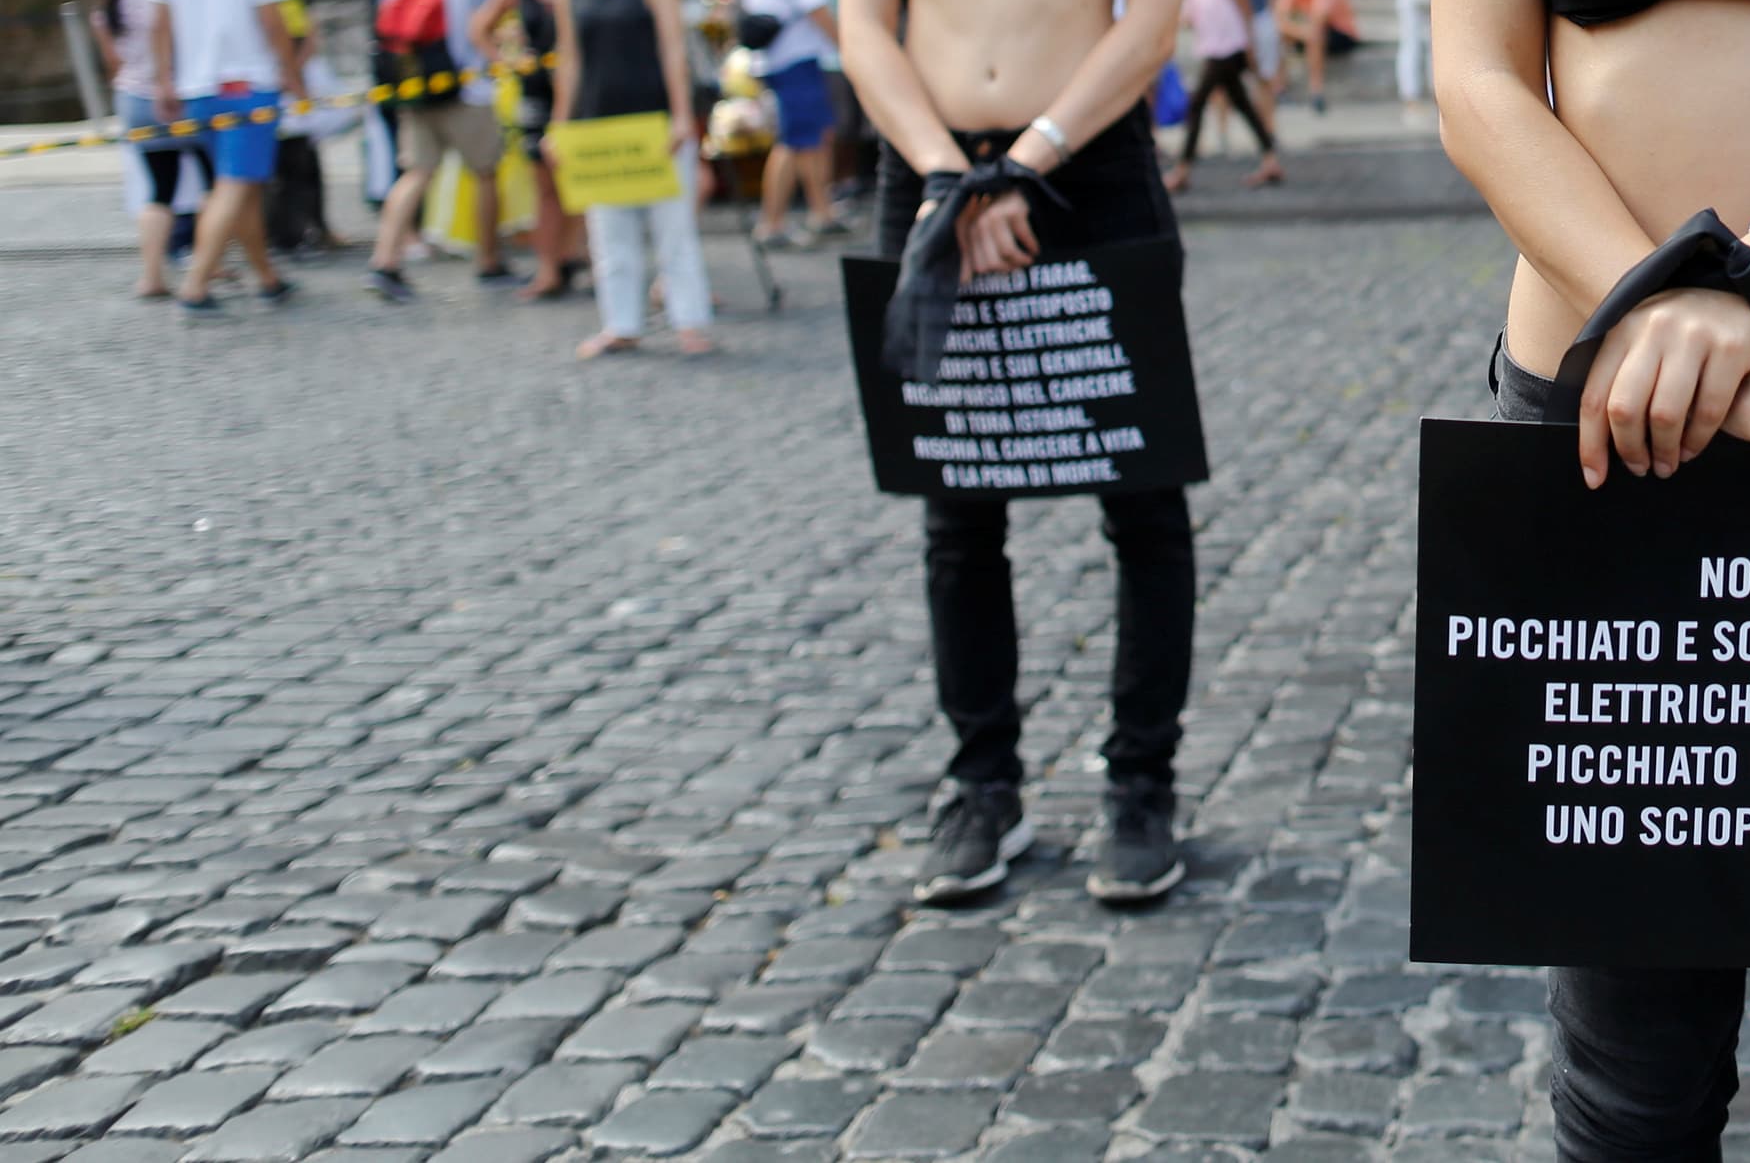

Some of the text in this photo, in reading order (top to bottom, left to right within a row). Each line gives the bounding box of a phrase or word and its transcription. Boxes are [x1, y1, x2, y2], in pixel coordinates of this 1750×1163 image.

[1029, 259, 1098, 290] FARAG.
[979, 299, 993, 324] E
[995, 287, 1114, 323] SOTTOPOSTO
[943, 316, 1114, 353] RICHE ELETTRICHE
[936, 343, 1131, 380] ORPO E SUI GENITALI.
[1011, 381, 1048, 406] NEL
[1049, 370, 1137, 403] CARCERE
[945, 410, 967, 435] DI
[967, 410, 1013, 435] TORA
[913, 425, 1145, 462] RISCHIA IL CARCERE A VITA
[942, 457, 1122, 488] O LA PENA DI MORTE.
[1448, 615, 1661, 662] PICCHIATO
[1676, 620, 1699, 662] E
[1527, 743, 1737, 786] PICCHIATO
[1545, 804, 1625, 845] UNO
